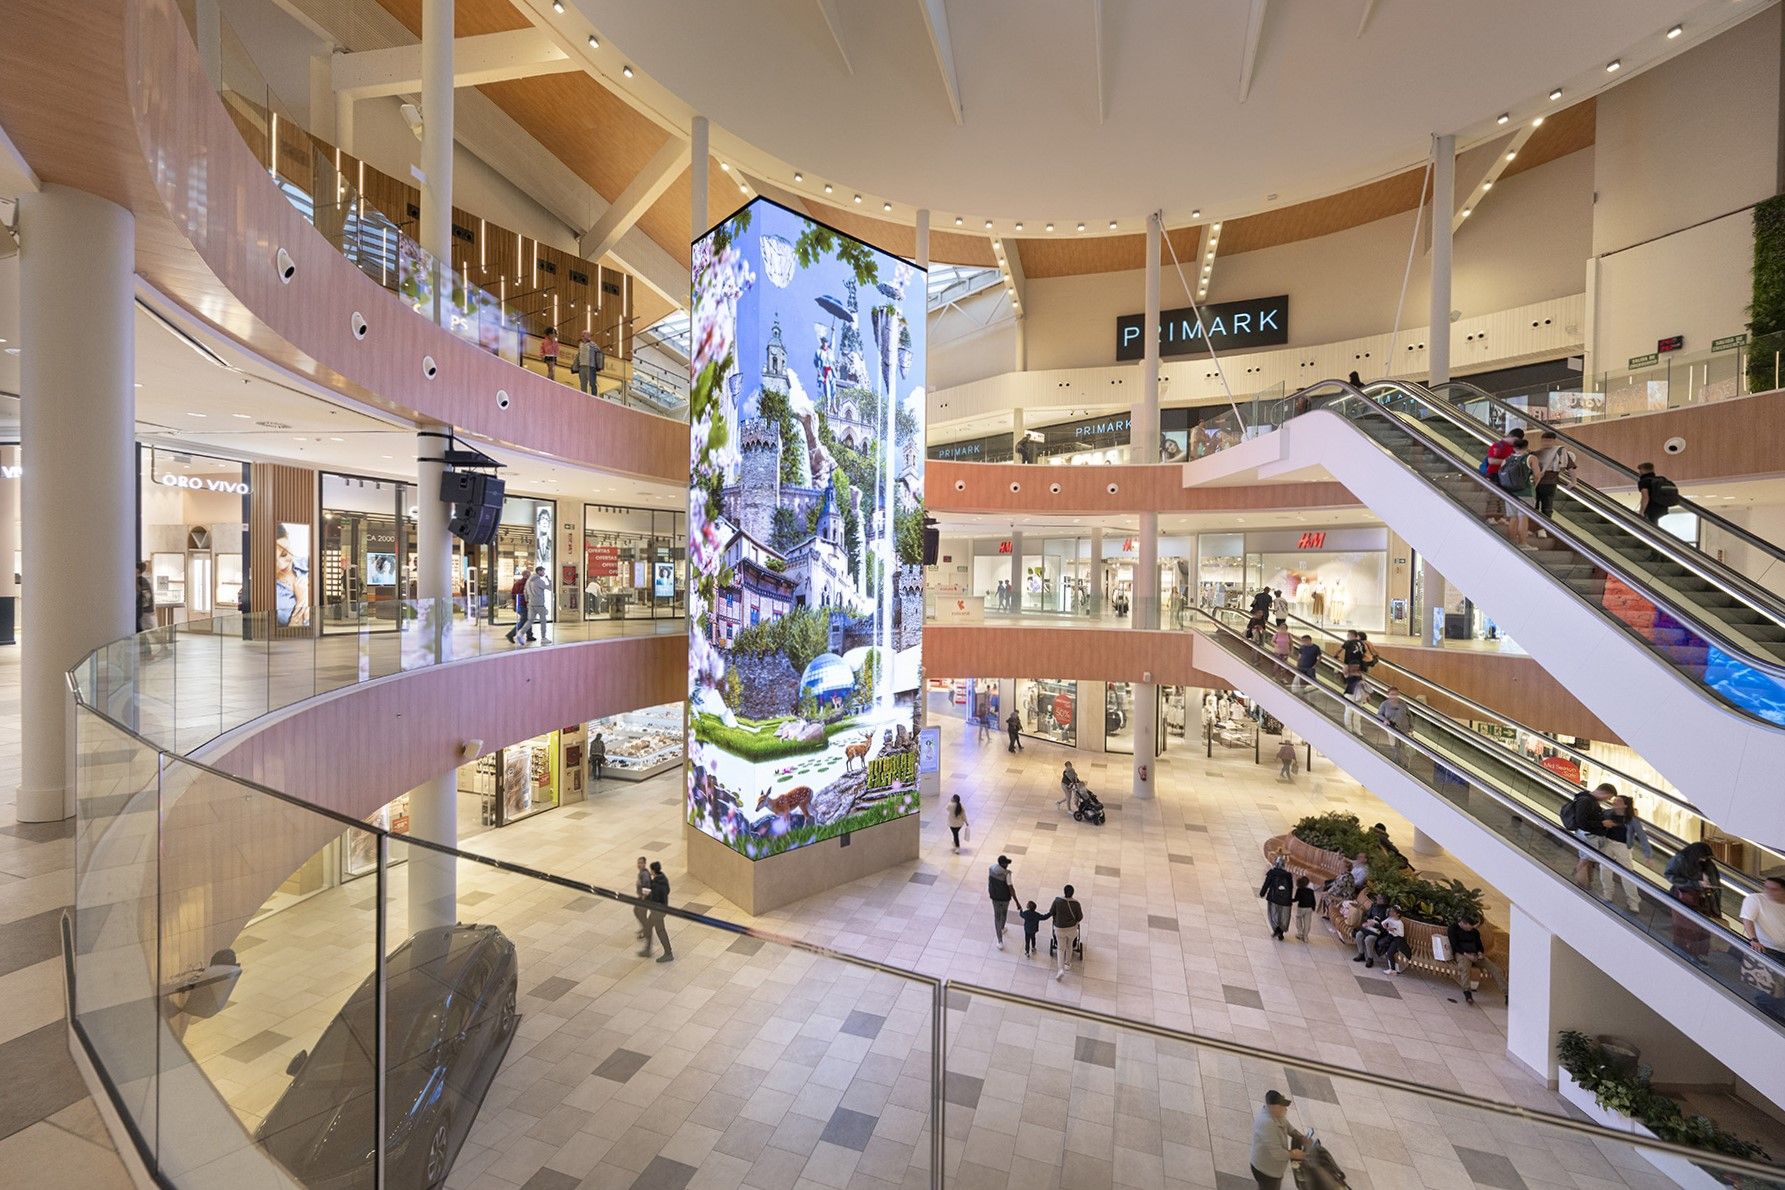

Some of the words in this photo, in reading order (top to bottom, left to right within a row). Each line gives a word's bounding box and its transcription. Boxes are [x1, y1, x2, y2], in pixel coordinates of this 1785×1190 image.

[1075, 419, 1132, 438] PRIMARK
[938, 444, 980, 459] PRIMARK
[162, 475, 203, 490] ORO
[207, 479, 249, 495] VIVO
[378, 534, 396, 543] 2000
[1296, 532, 1326, 549] H&M
